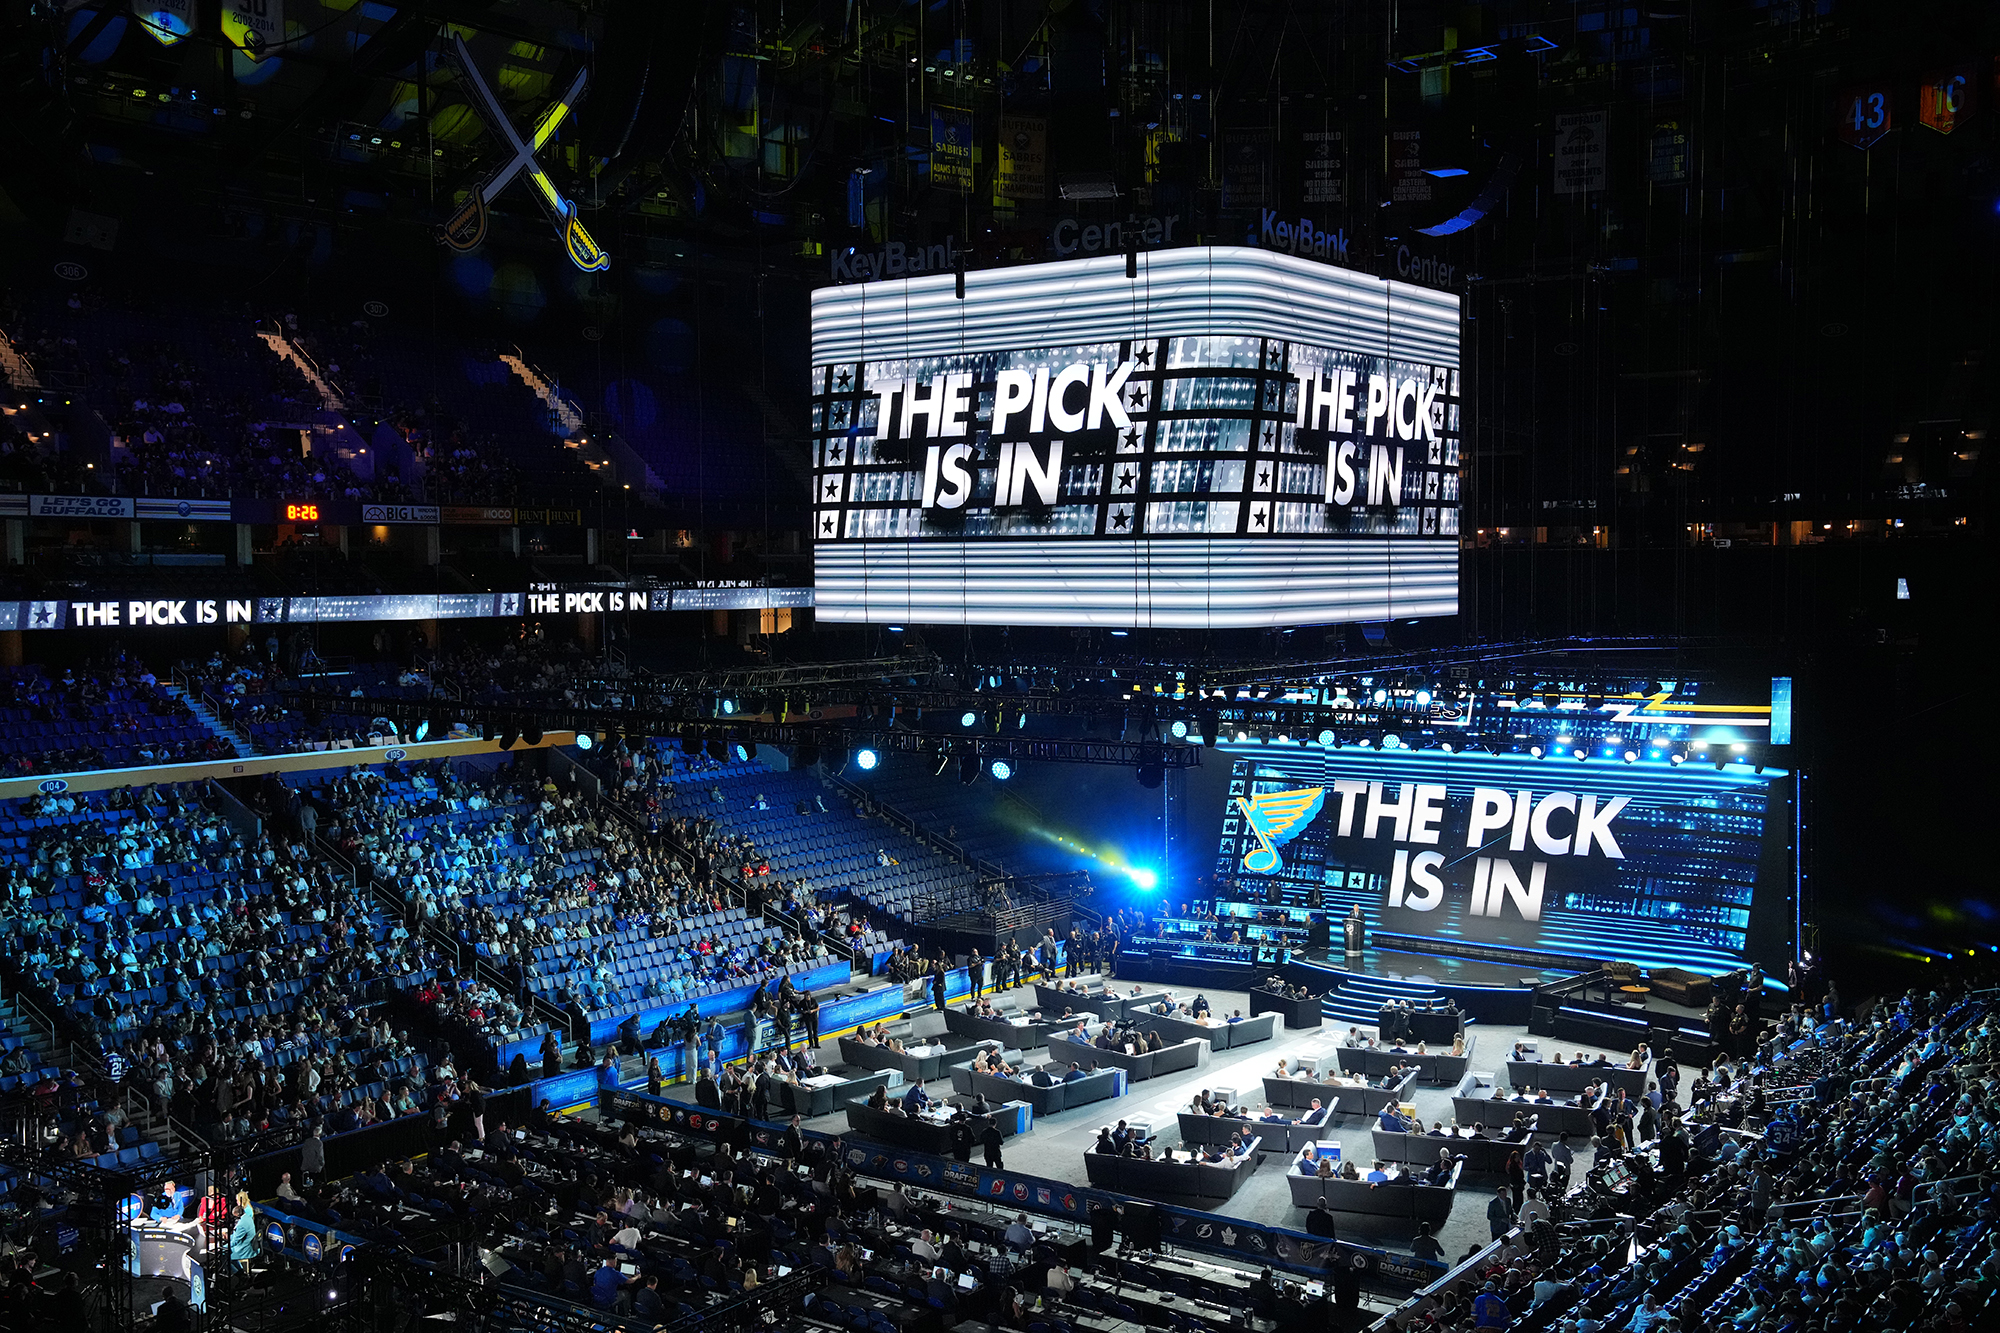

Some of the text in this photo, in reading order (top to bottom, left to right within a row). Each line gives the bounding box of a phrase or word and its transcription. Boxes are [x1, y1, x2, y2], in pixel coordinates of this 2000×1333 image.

[232, 12, 275, 32] 2002-2014
[1933, 75, 1966, 115] 16
[1845, 92, 1885, 131] 43
[1002, 119, 1044, 132] BUFFALO
[1561, 114, 1602, 126] BUFFALO
[1302, 131, 1342, 141] BUFFALO
[935, 142, 969, 156] SABRES
[1561, 144, 1600, 155] SABRES
[1003, 152, 1042, 163] SABRES
[1305, 159, 1342, 169] SABRES
[1398, 178, 1427, 186] EASTERN
[1000, 183, 1044, 194] CHAMPIONS
[1392, 186, 1432, 194] CONFERENCE
[1303, 194, 1342, 203] CHAMPIONS
[1392, 193, 1432, 202] CHAMPIONS
[1261, 207, 1350, 263] KeyBank
[62, 265, 80, 277] 306
[1396, 244, 1455, 287] Center
[370, 304, 383, 315] 307
[872, 361, 1136, 441] THE PICK
[1295, 366, 1440, 441] THE PICK
[921, 440, 1063, 510] IS IN
[1325, 440, 1404, 507] IS IN
[43, 497, 122, 507] LET'S GO
[39, 506, 125, 516] BUFFALO!
[287, 505, 319, 520] 8:26
[387, 507, 418, 521] BIG L
[484, 509, 512, 519] NOCO
[519, 510, 545, 521] HUNT
[551, 510, 576, 521] HUNT
[528, 591, 647, 614] THE PICK IS IN
[72, 599, 252, 627] THE PICK IS IN
[45, 781, 61, 792] 104
[1333, 780, 1634, 860] THE PICK
[1387, 849, 1547, 922] IS IN
[1773, 1132, 1790, 1144] 34
